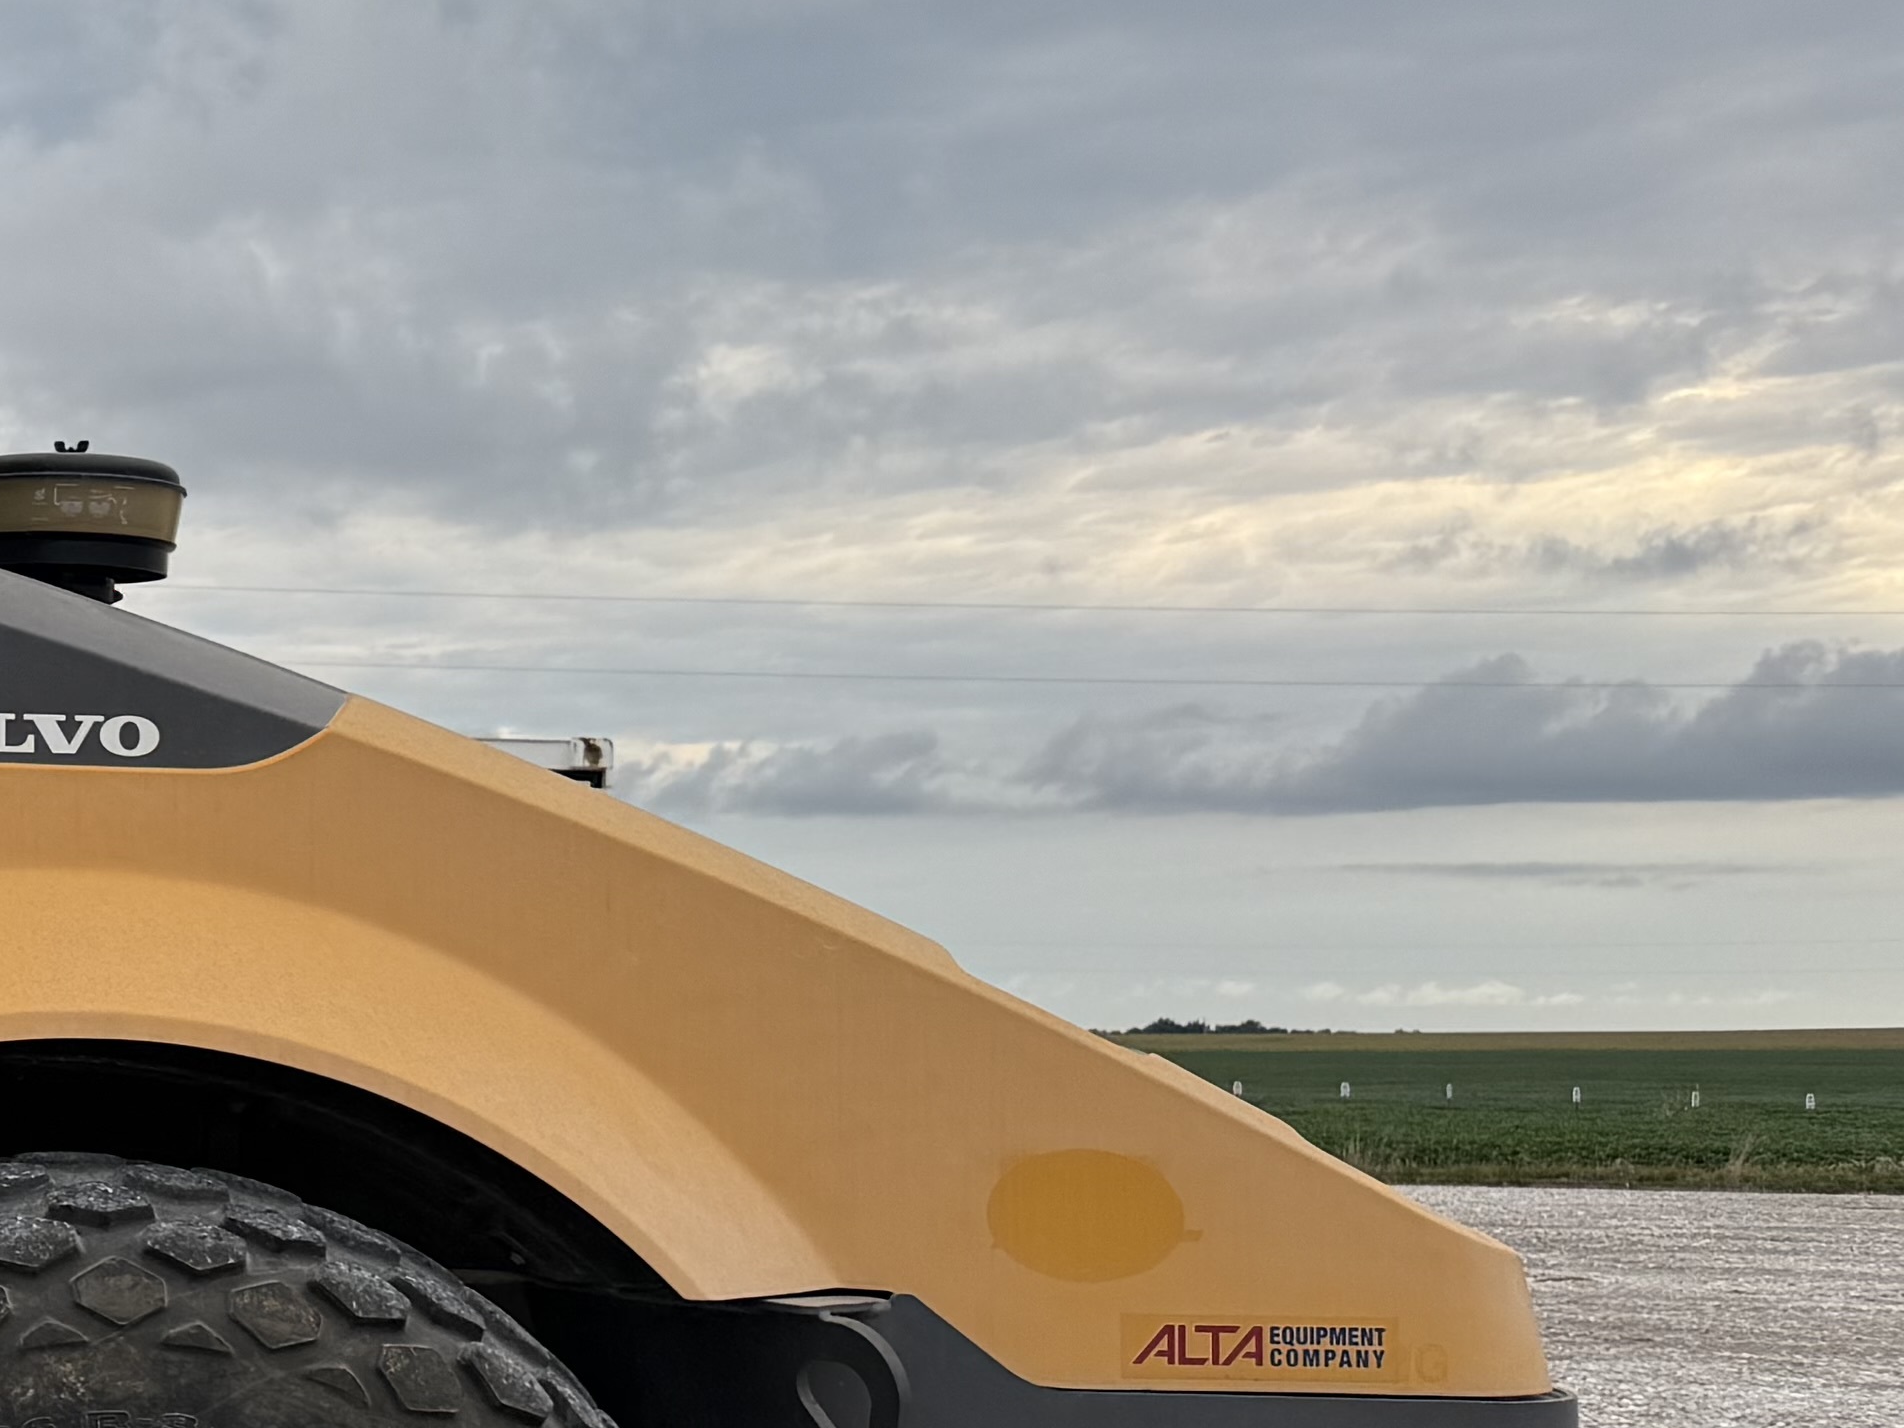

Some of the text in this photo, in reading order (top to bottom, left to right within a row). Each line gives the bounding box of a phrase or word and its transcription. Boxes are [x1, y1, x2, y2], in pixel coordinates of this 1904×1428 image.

[1132, 1324, 1264, 1367] ALTA
[1269, 1326, 1386, 1347] EQUIPMENT
[1269, 1349, 1386, 1369] COMPANY
